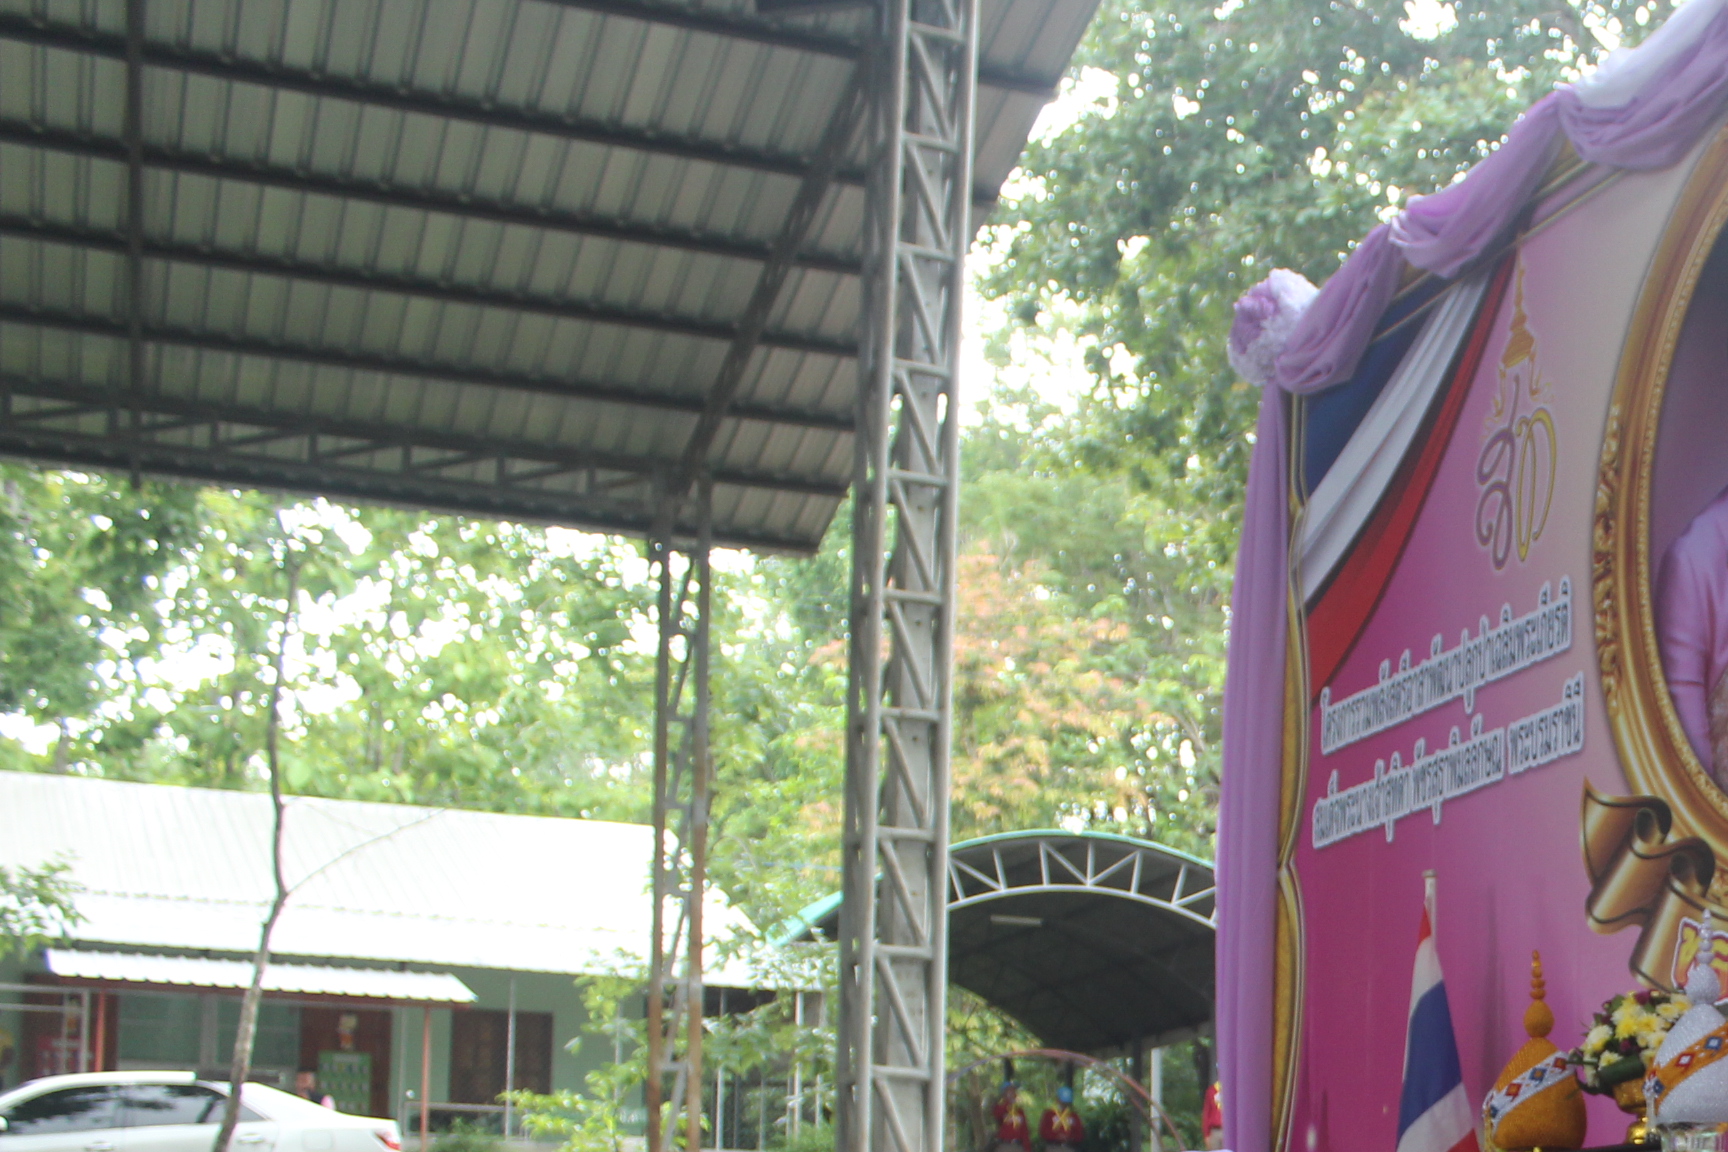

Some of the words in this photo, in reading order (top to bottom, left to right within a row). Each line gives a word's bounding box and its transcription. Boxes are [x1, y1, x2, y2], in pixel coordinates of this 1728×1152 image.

[1509, 675, 1582, 770] พระบรมราชินี
